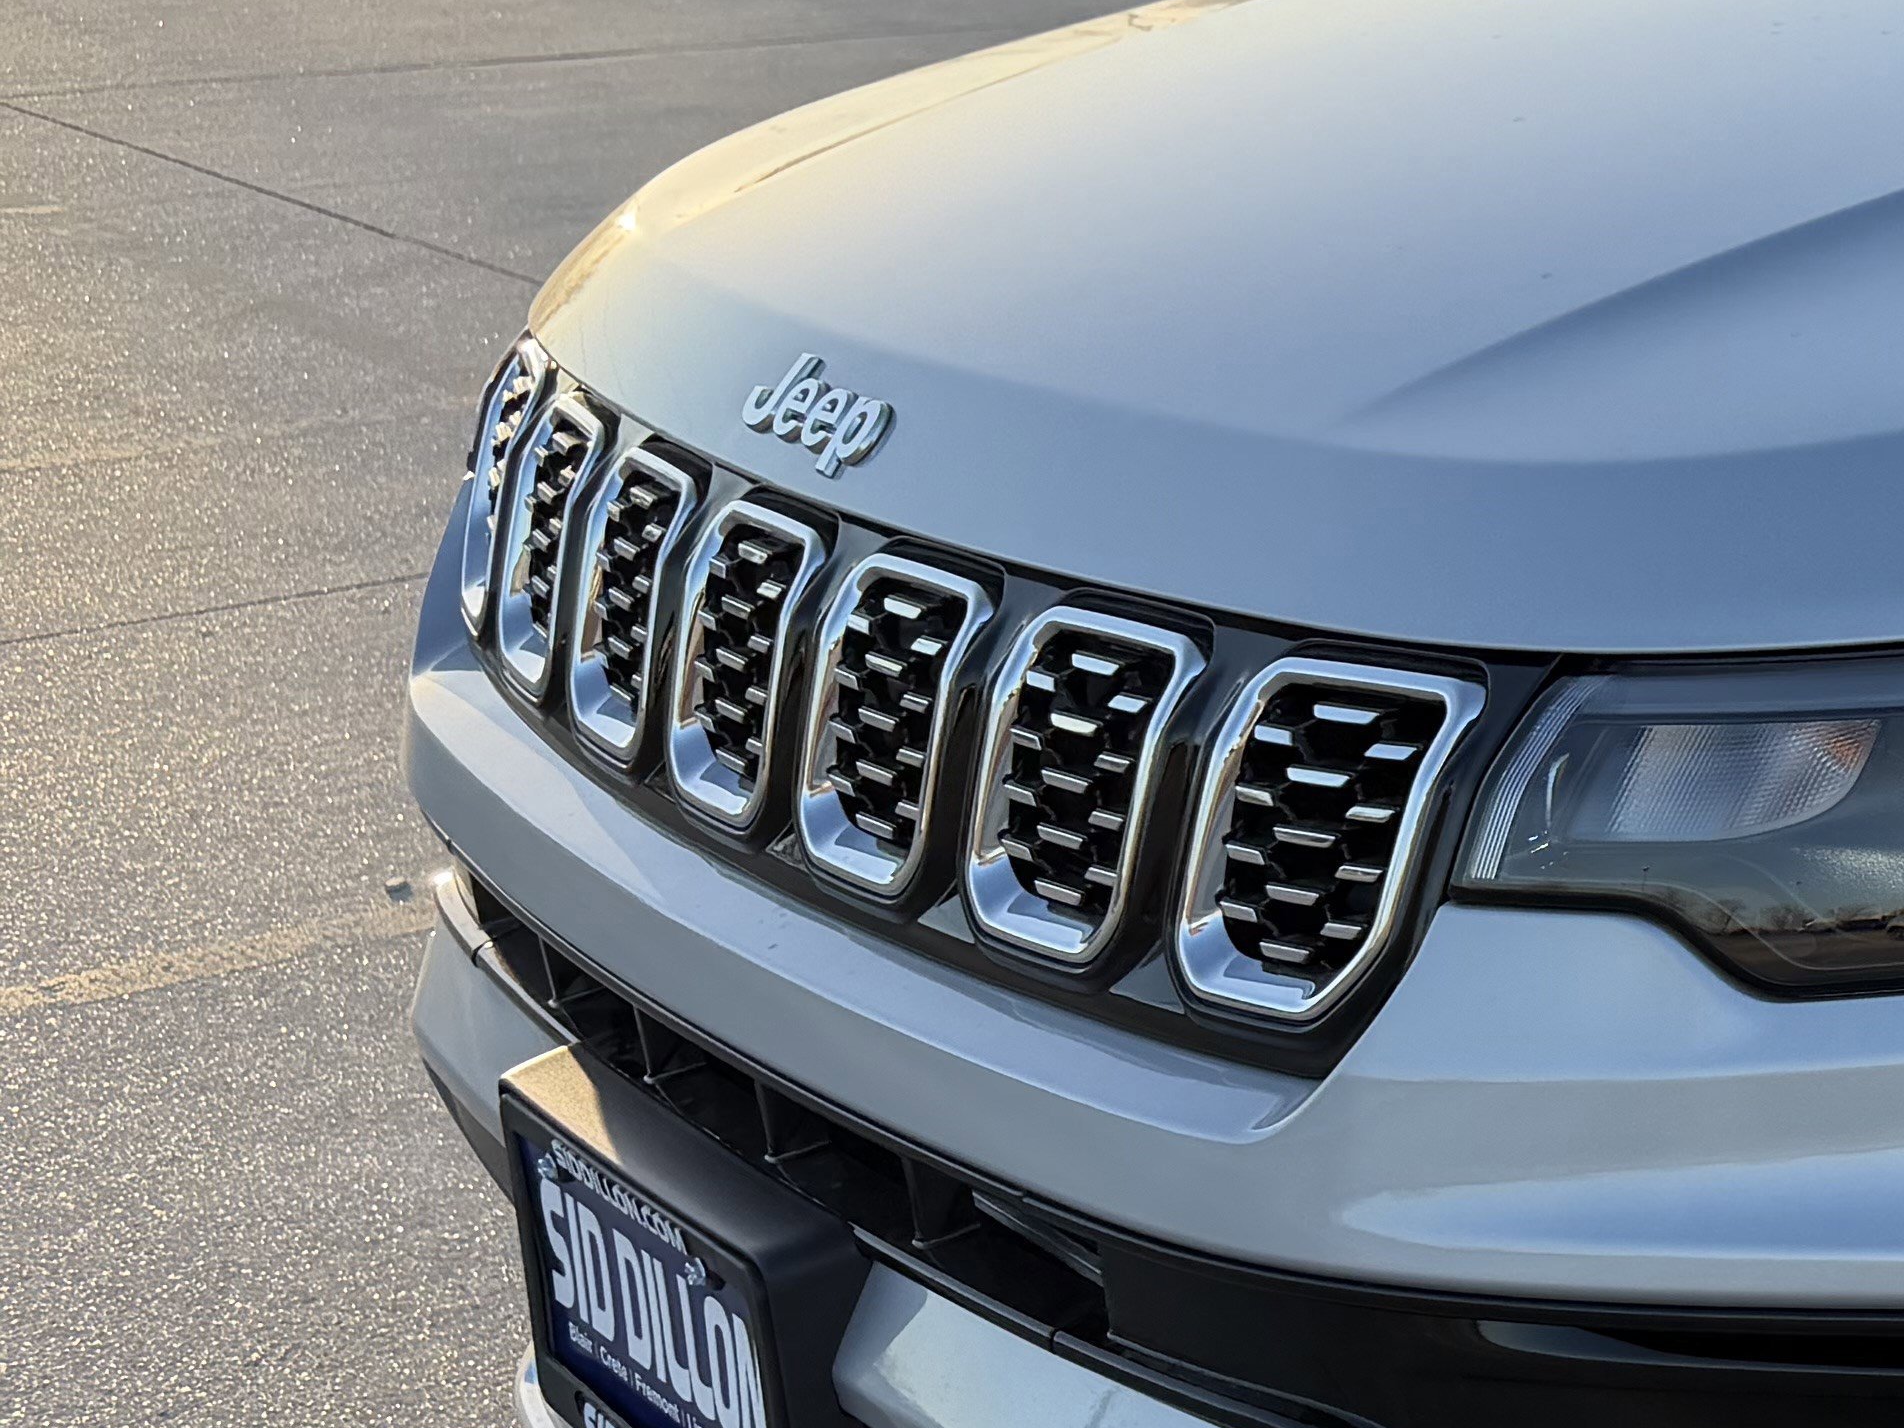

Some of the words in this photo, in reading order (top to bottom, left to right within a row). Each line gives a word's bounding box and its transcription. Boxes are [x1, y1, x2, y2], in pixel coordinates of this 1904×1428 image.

[742, 352, 896, 480] Jeep
[540, 1177, 616, 1343] SID
[634, 1372, 680, 1423] Fremont
